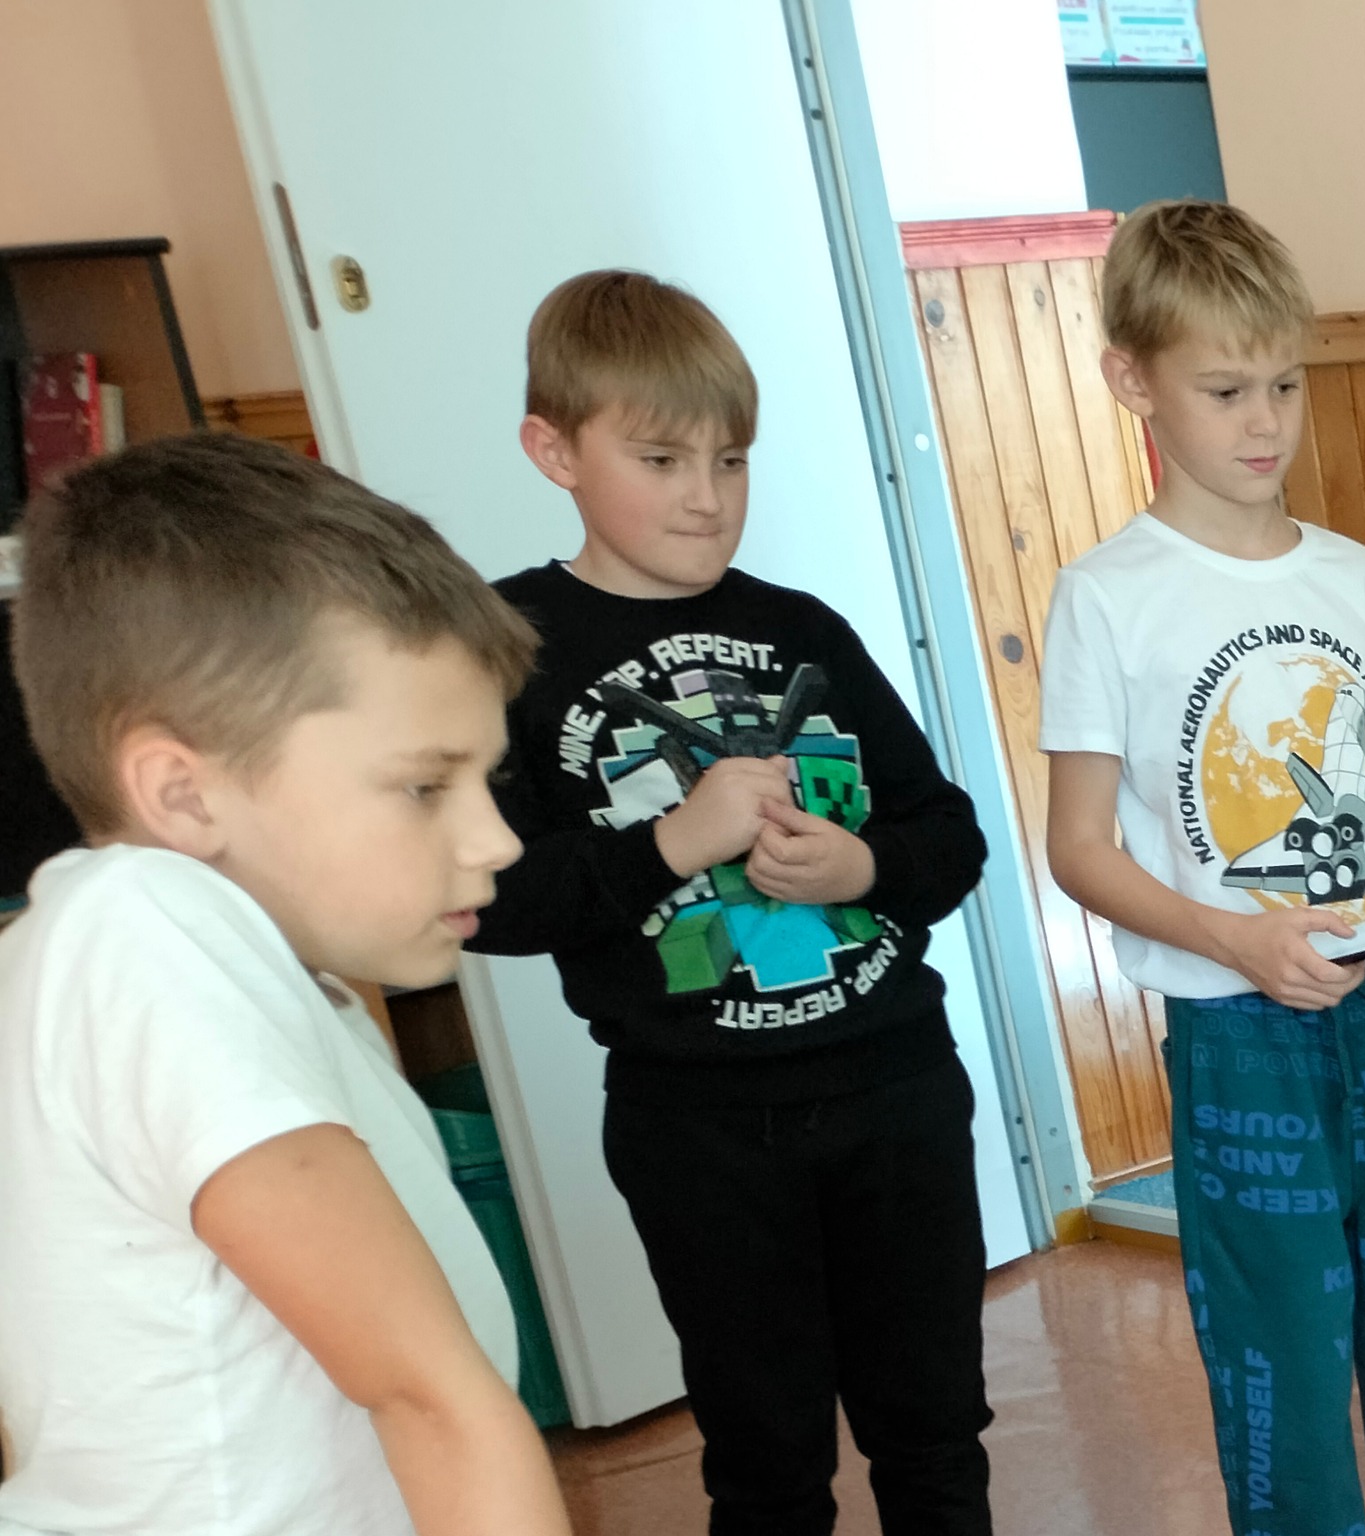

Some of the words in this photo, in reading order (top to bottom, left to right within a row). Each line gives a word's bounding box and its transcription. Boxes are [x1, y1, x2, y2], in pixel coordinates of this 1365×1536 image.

[1265, 624, 1306, 646] AND
[1309, 628, 1363, 674] SPACE
[559, 704, 607, 780] MINE.
[648, 633, 783, 672] REPEAT.
[1180, 628, 1264, 755] AERONAUTICS
[1176, 758, 1216, 865] NATIONAL
[712, 984, 847, 1030] REPEAT.
[1218, 1144, 1303, 1177] AND
[1236, 1186, 1341, 1214] KEEP
[1245, 1347, 1274, 1510] YOURSELF
